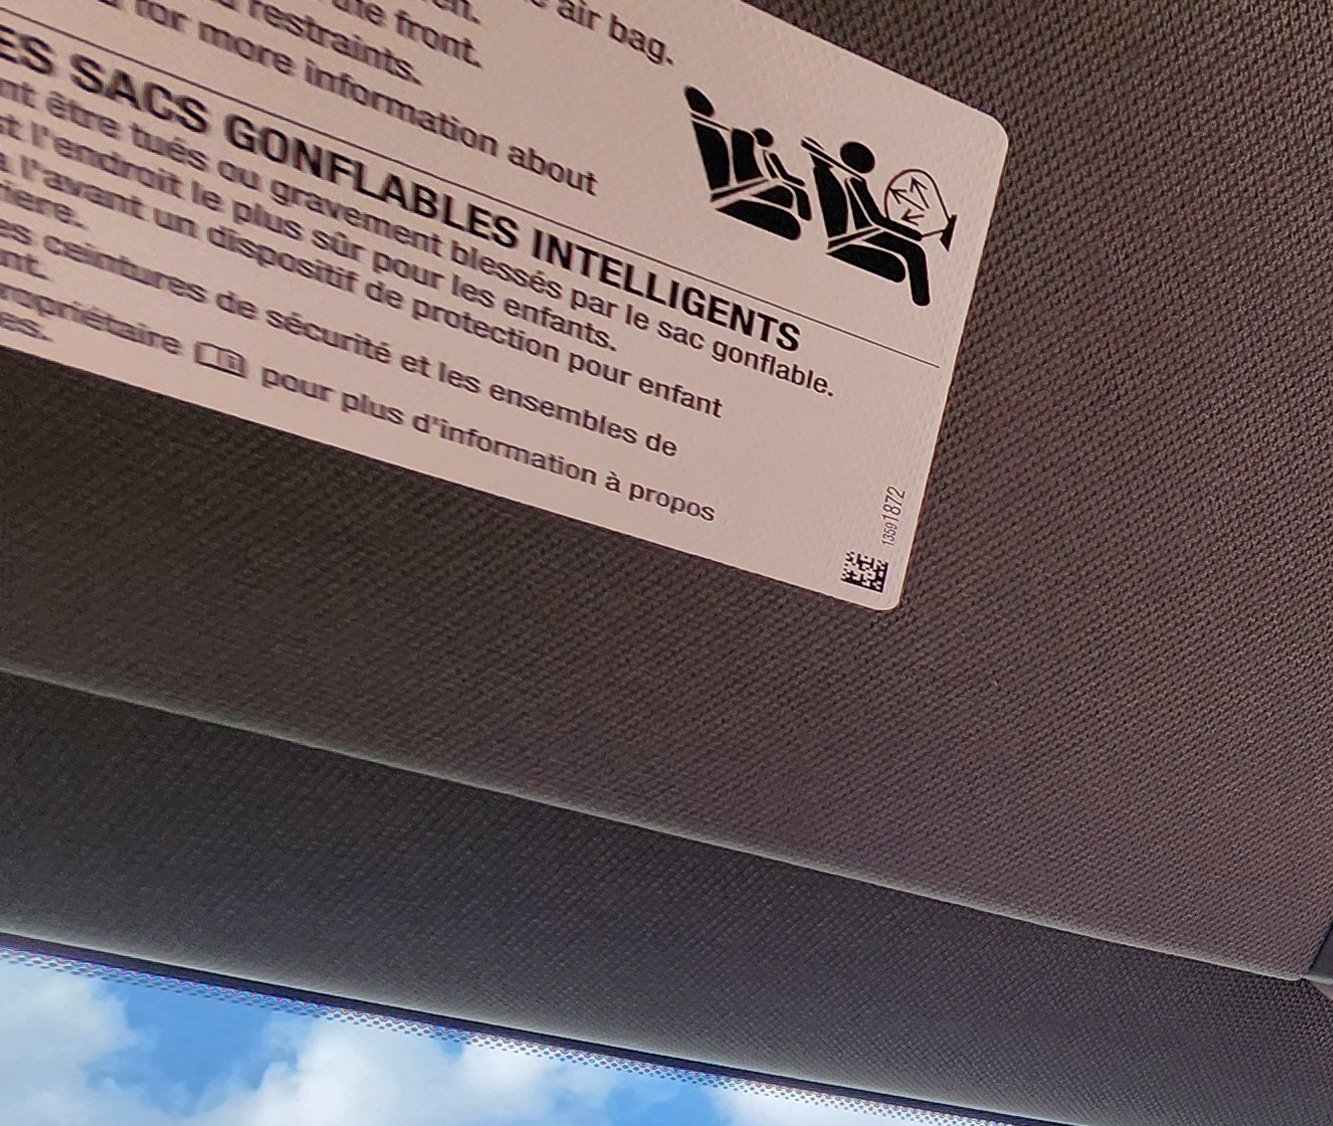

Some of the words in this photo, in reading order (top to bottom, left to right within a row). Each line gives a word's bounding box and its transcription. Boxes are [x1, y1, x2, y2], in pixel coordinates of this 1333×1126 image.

[198, 20, 296, 76] more
[304, 56, 498, 158] information
[507, 144, 599, 197] about
[248, 0, 424, 87] restraints.
[394, 9, 484, 69] front.
[608, 13, 675, 66] bag.
[30, 120, 186, 201] l'endroit
[191, 179, 225, 213] le
[233, 199, 304, 242] plus
[311, 228, 367, 263] sûr
[372, 250, 446, 290] pour
[451, 273, 496, 309] les
[503, 297, 618, 352] enfants.
[46, 90, 123, 141] être
[129, 121, 212, 173] tués
[217, 159, 261, 191] ou
[269, 178, 444, 260] gravement
[449, 239, 564, 301] blessés
[570, 286, 620, 319] par
[624, 303, 651, 331] le
[656, 319, 706, 351] sac
[711, 338, 835, 399] gonflable.
[69, 52, 211, 136] SACS
[222, 112, 520, 249] GONFLABLES
[531, 227, 802, 352] INTELLIGENTS
[43, 234, 209, 304] ceintures
[215, 290, 260, 321] de
[265, 309, 393, 365] sécurité
[400, 353, 433, 379] et
[438, 360, 483, 394] les
[489, 383, 639, 445] ensembles
[645, 432, 679, 457] de
[154, 207, 202, 240] un
[207, 224, 359, 294] dispositif
[365, 280, 404, 310] de
[412, 298, 561, 364] protection
[568, 351, 633, 388] pour
[638, 374, 724, 419] enfant
[261, 366, 335, 403] pour
[341, 391, 405, 426] plus
[412, 412, 598, 486] d'information
[604, 471, 622, 494] à
[628, 481, 717, 522] propos
